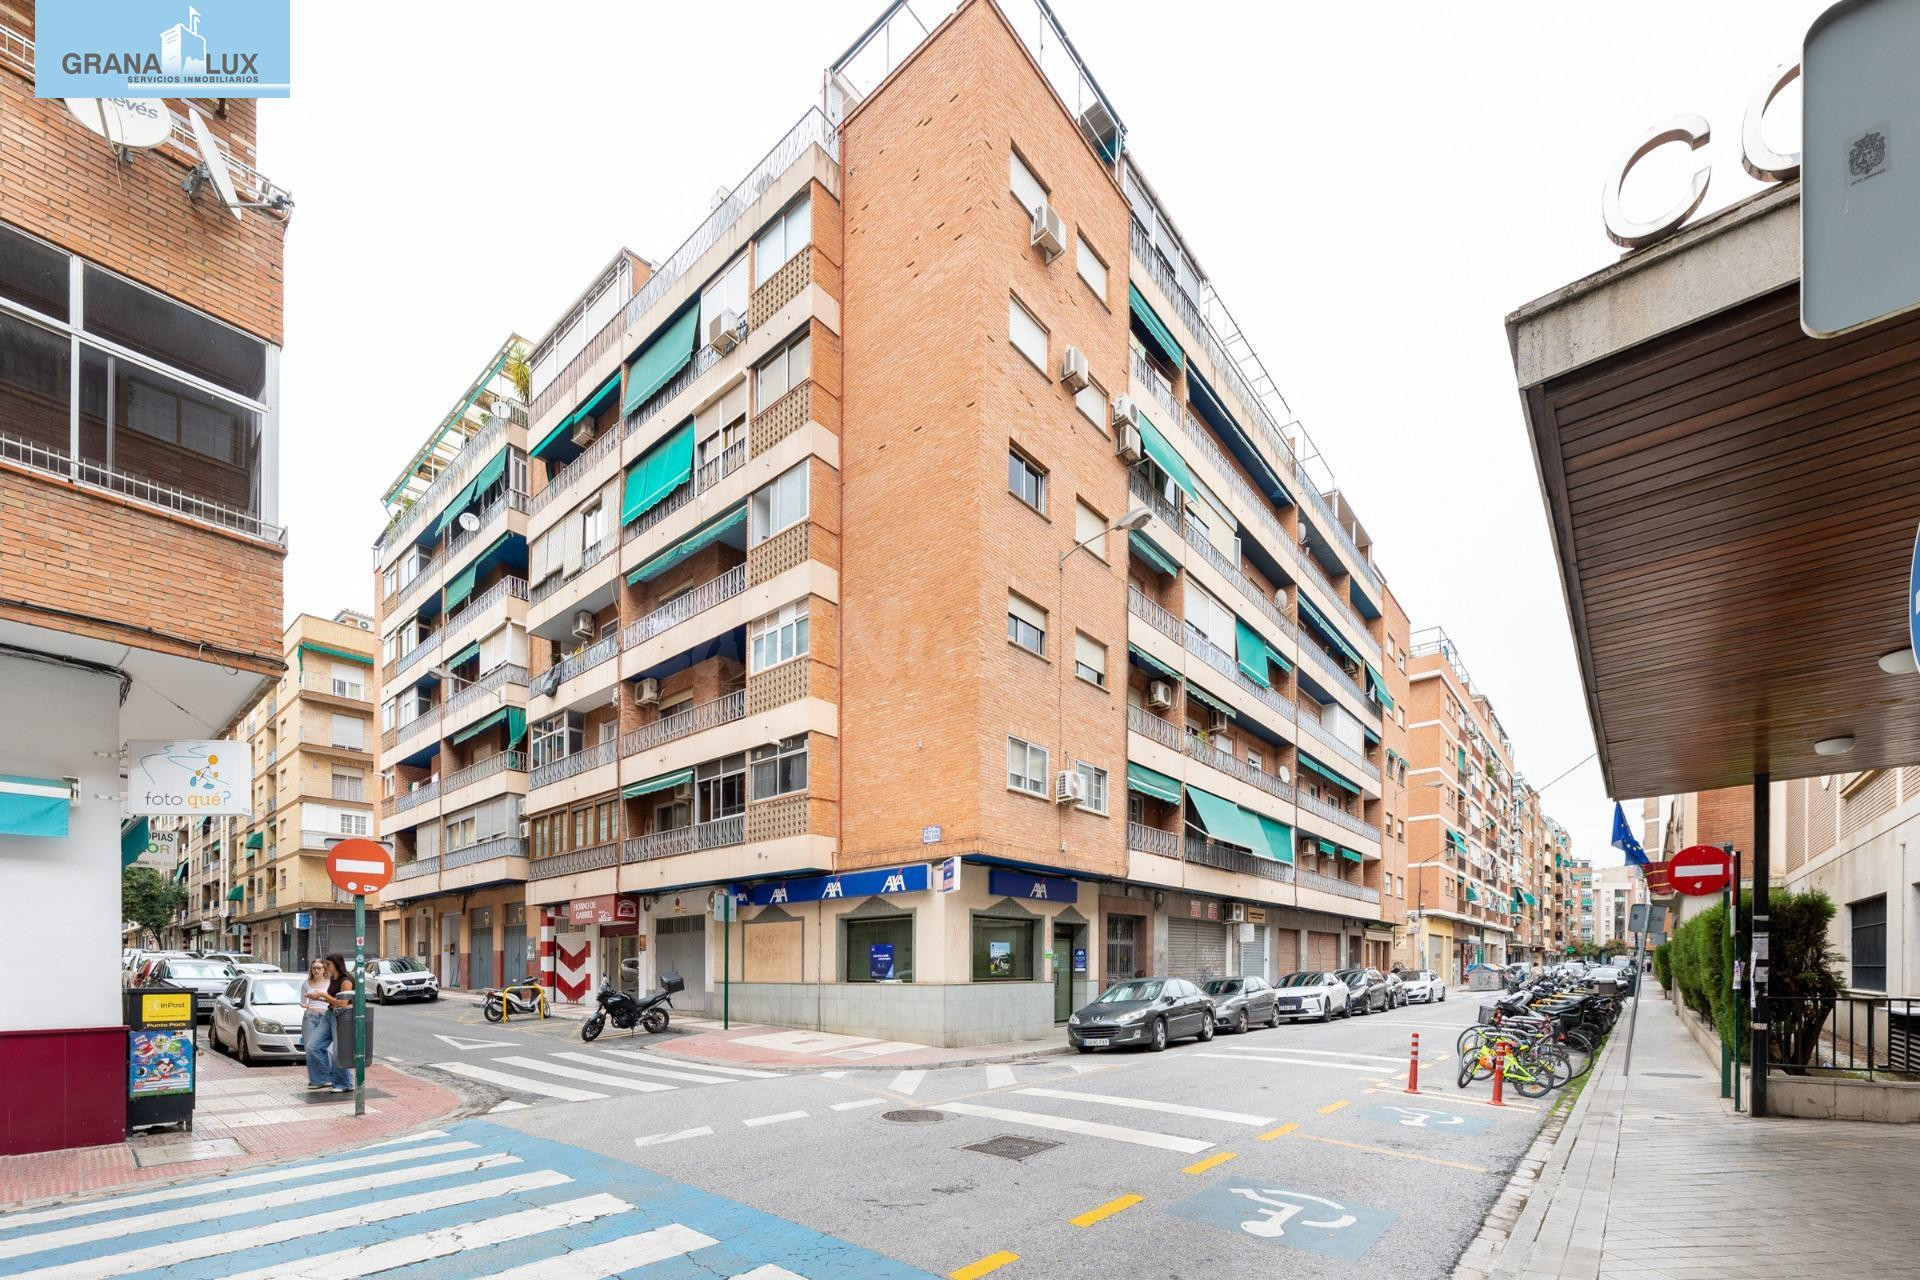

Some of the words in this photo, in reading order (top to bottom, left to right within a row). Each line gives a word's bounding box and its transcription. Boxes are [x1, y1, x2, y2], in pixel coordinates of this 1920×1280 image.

[108, 98, 158, 119] evés
[145, 791, 183, 806] foto
[144, 843, 170, 854] OR
[822, 881, 842, 898] AXA
[881, 874, 905, 892] AXA
[1030, 882, 1047, 899] AXA
[769, 887, 788, 903] AXA
